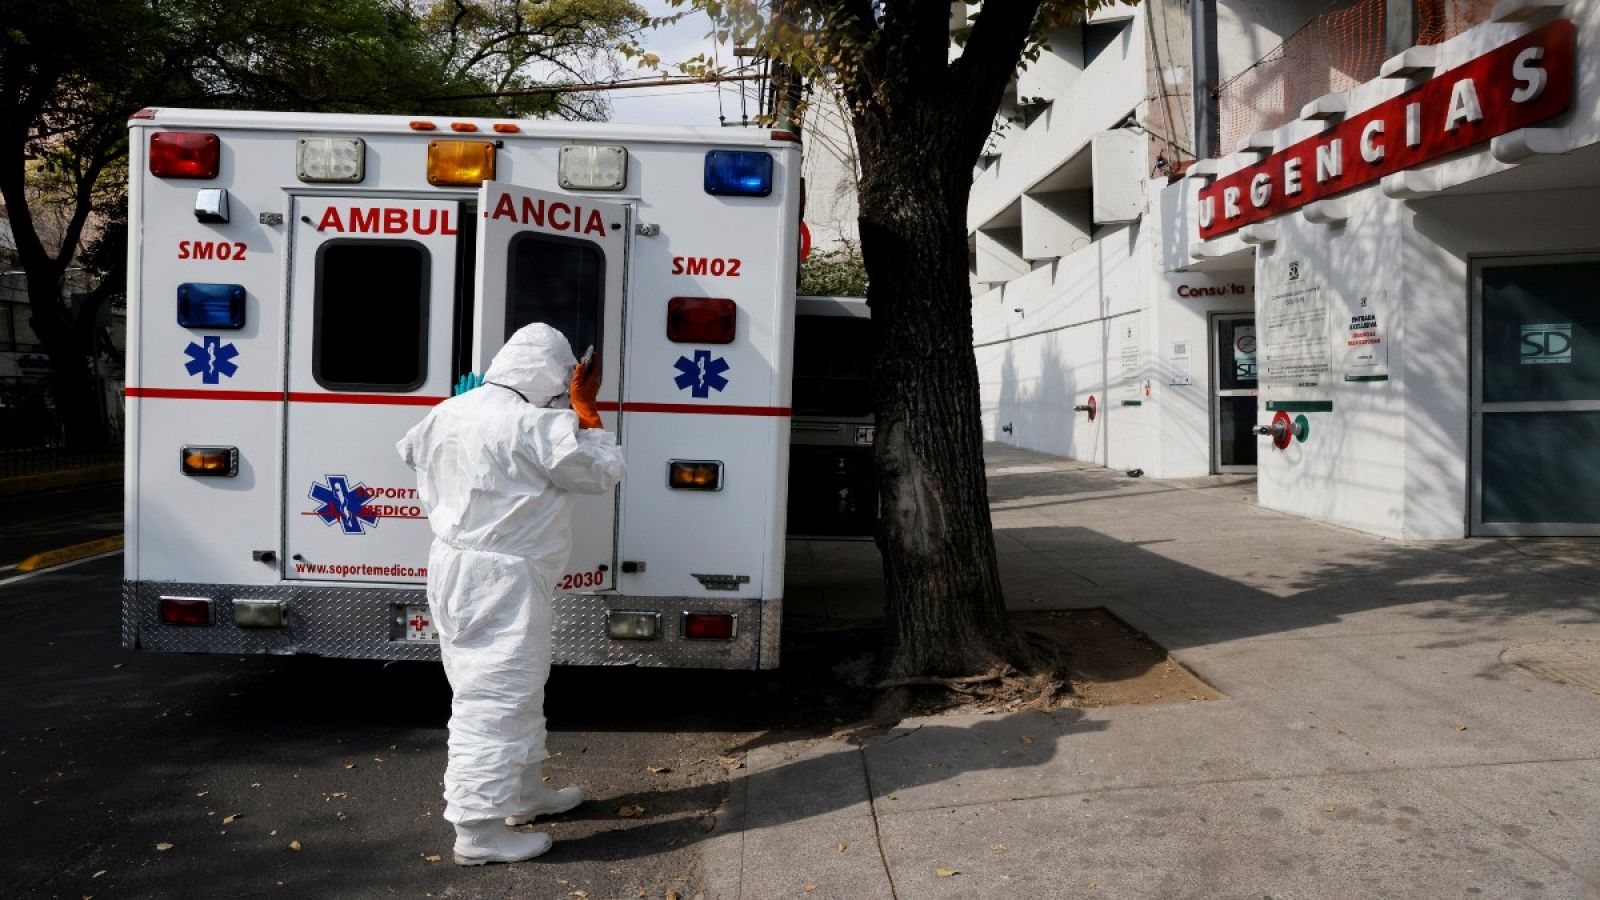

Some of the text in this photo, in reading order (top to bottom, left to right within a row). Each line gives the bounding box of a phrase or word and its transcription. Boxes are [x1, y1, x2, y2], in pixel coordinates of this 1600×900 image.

[1198, 46, 1549, 230] URGENCIAS
[318, 206, 459, 236] AMBUL
[177, 240, 248, 262] SM02
[671, 256, 742, 278] SM02
[1521, 331, 1571, 357] SD
[554, 570, 604, 590] -2030
